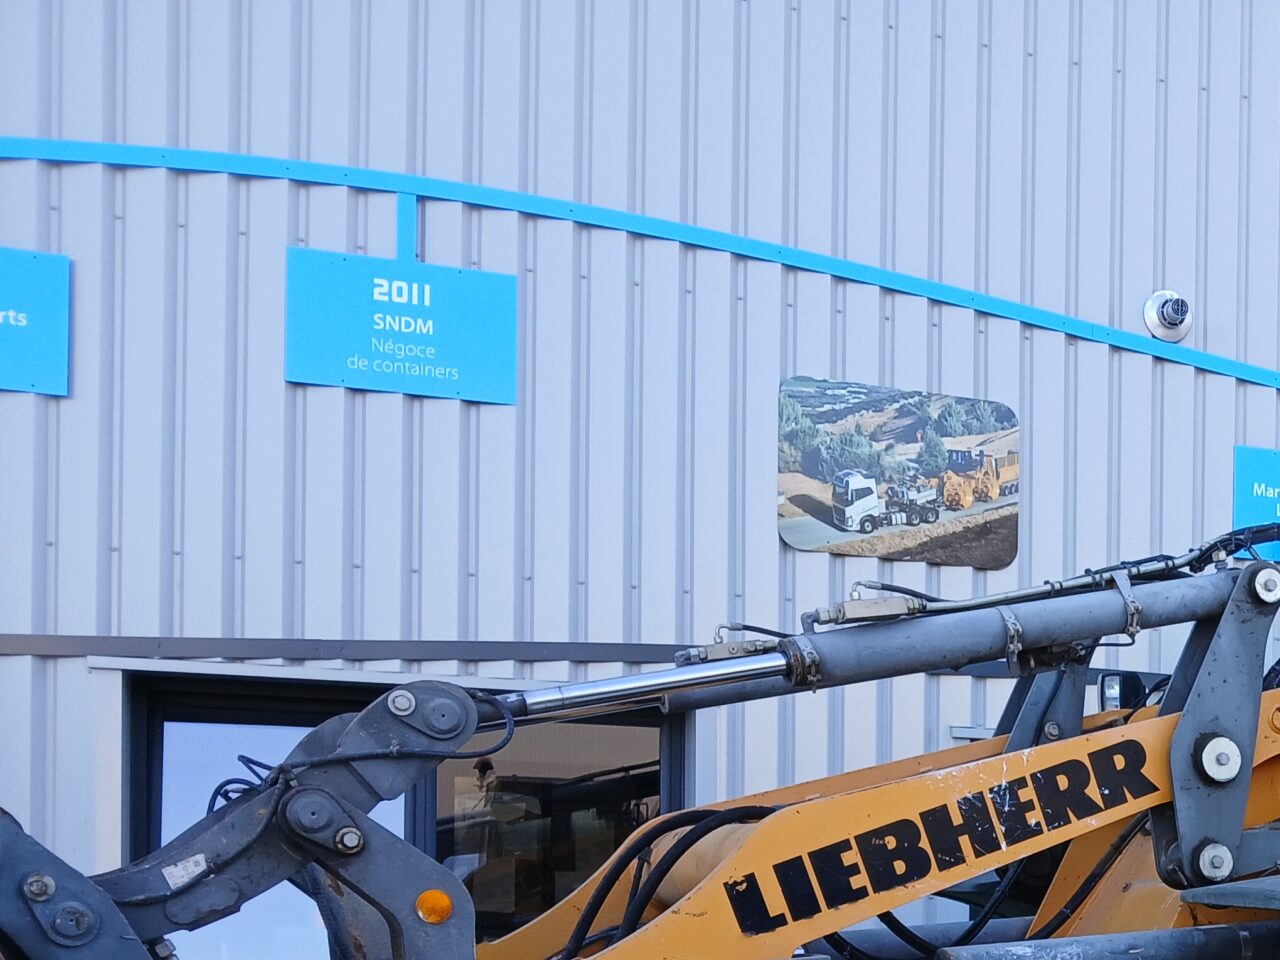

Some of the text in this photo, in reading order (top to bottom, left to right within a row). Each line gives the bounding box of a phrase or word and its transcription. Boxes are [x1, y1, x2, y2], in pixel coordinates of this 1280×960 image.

[373, 278, 430, 306] 2011
[373, 313, 433, 335] SNDM
[371, 337, 435, 359] Négoce
[347, 354, 459, 380] de containers
[722, 739, 1160, 936] LIEBHERR
